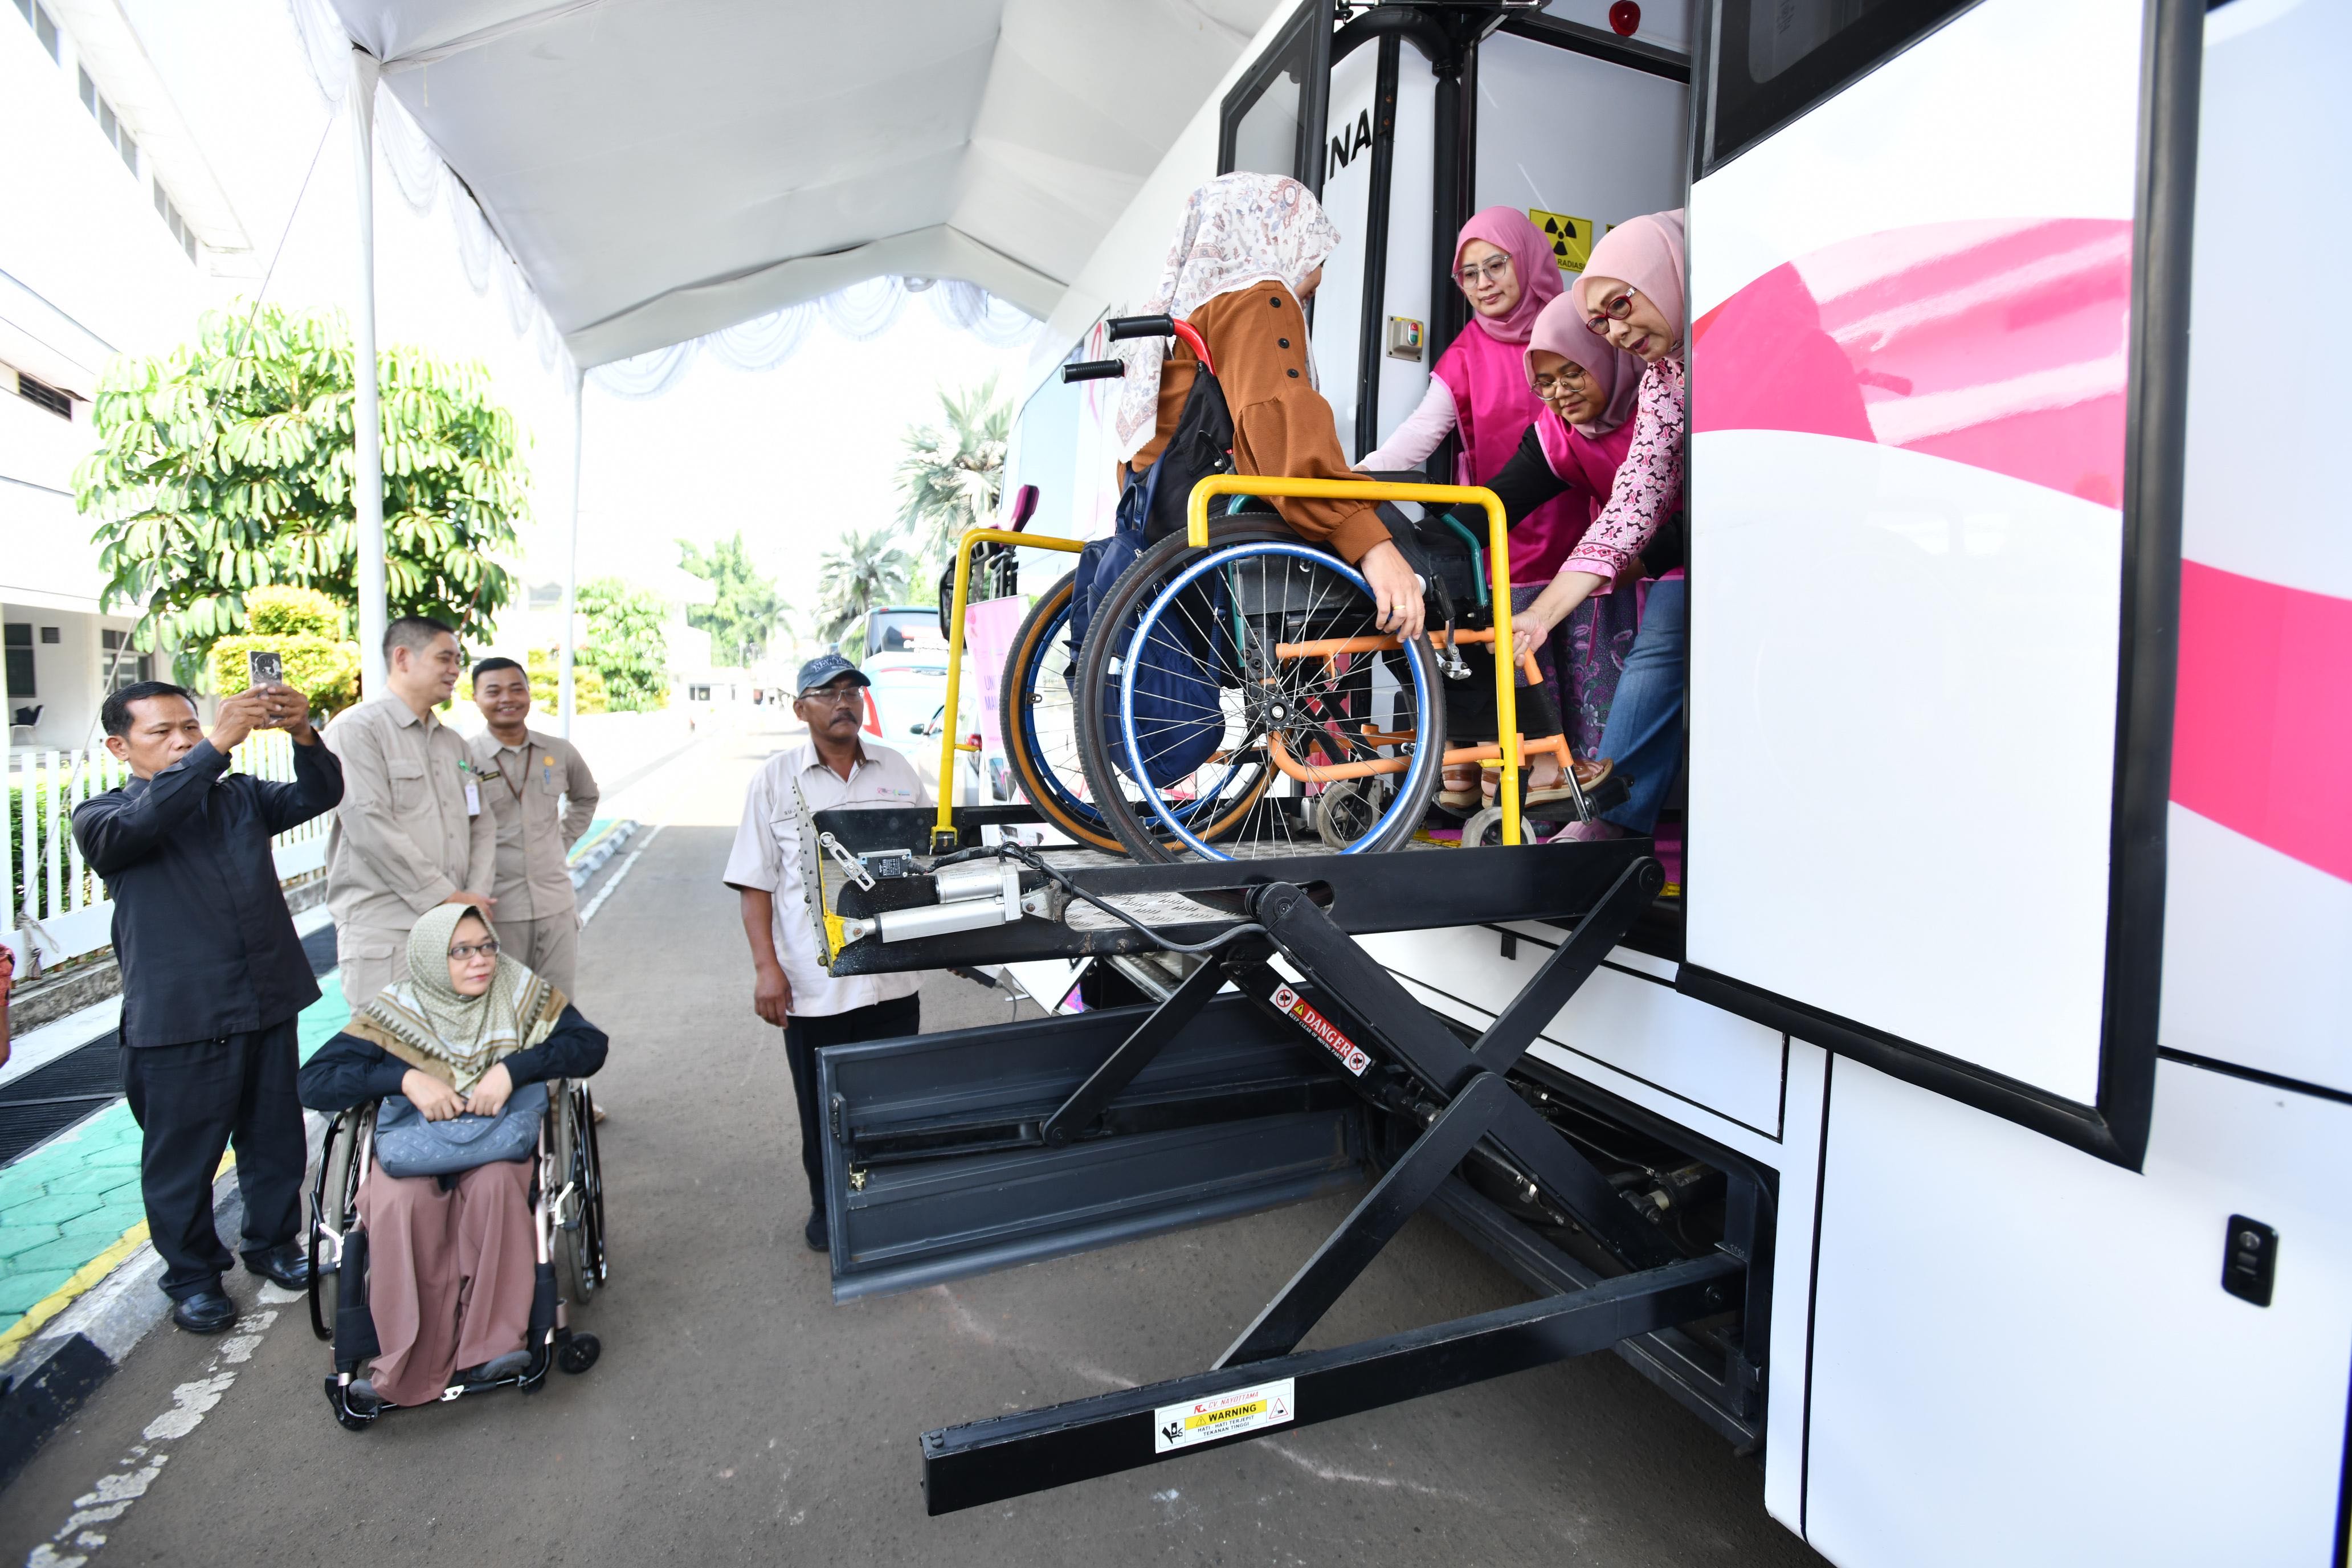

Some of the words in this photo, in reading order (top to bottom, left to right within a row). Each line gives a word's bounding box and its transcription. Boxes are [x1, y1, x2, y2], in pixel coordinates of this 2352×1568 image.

[1558, 259, 1585, 270] RADIASI
[812, 658, 833, 672] NEW
[1289, 1012, 1300, 1022] KEEP
[1299, 1021, 1312, 1034] CLEAR
[1317, 1036, 1331, 1051] MOVING
[1331, 1049, 1344, 1061] PARTS
[1304, 1010, 1351, 1056] DANGER
[1220, 1391, 1259, 1405] NAYOTTAMA
[1208, 1404, 1256, 1422] WARNING
[1230, 1415, 1254, 1424] TERJEPIT
[1203, 1427, 1229, 1436] TEKANAN
